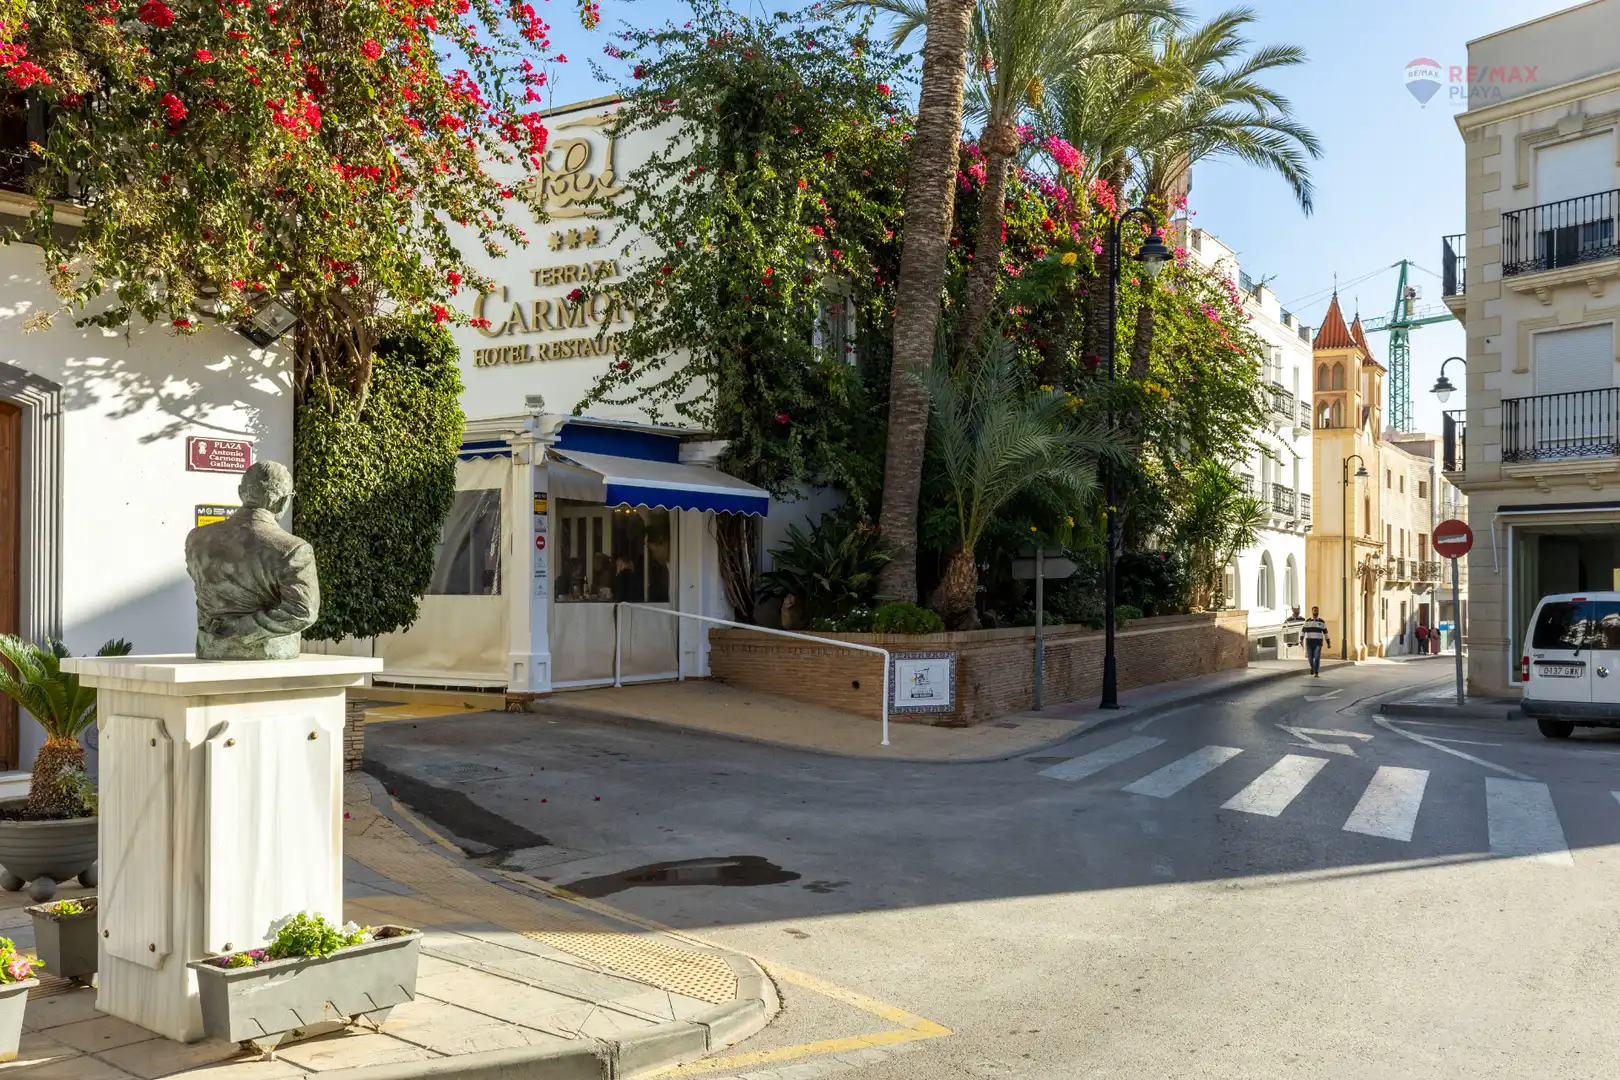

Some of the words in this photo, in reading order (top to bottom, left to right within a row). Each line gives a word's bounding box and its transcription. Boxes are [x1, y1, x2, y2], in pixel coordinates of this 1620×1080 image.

[530, 260, 618, 286] TERRAZA
[473, 285, 638, 338] CARMON
[472, 343, 532, 367] HOTEL
[536, 335, 622, 361] RESTAUR
[211, 449, 244, 457] Antonio
[214, 442, 242, 450] PLAZA
[209, 454, 246, 462] Carmona
